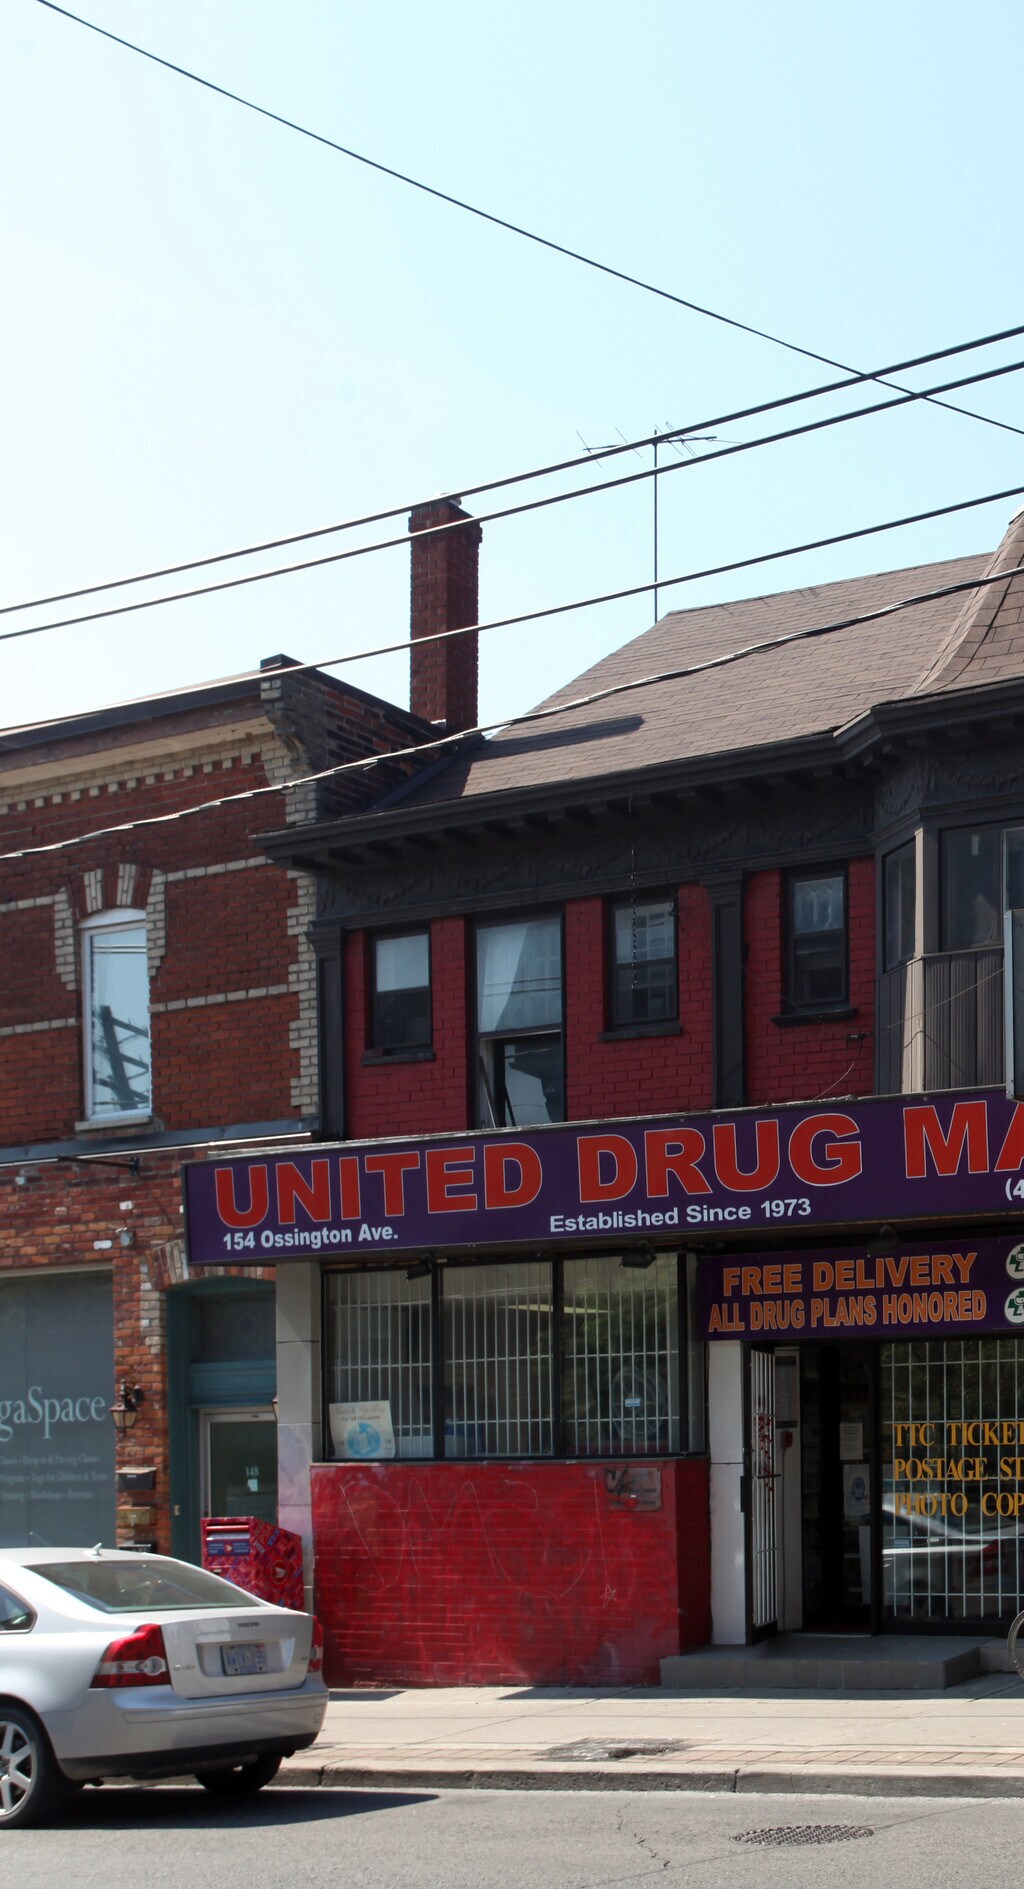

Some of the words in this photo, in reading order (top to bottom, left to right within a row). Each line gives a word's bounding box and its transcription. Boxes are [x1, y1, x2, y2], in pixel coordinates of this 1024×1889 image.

[215, 1142, 543, 1229] UNITED
[576, 1113, 863, 1202] DRUG
[223, 1231, 255, 1251] 154
[261, 1226, 352, 1249] Ossington
[358, 1224, 398, 1241] Ave.
[550, 1207, 679, 1232] Established
[686, 1205, 751, 1223] Since
[761, 1198, 811, 1218] 1973
[723, 1263, 803, 1296] FREE
[813, 1252, 978, 1291] DELIVERY
[708, 1302, 745, 1332] ALL
[750, 1299, 805, 1330] DRUG
[811, 1295, 877, 1327] PLANS
[882, 1290, 987, 1325] HONORED
[893, 1423, 935, 1447] TTC
[246, 1466, 259, 1476] 148
[894, 1457, 988, 1482] POSTAGE
[894, 1492, 968, 1517] PHOTO
